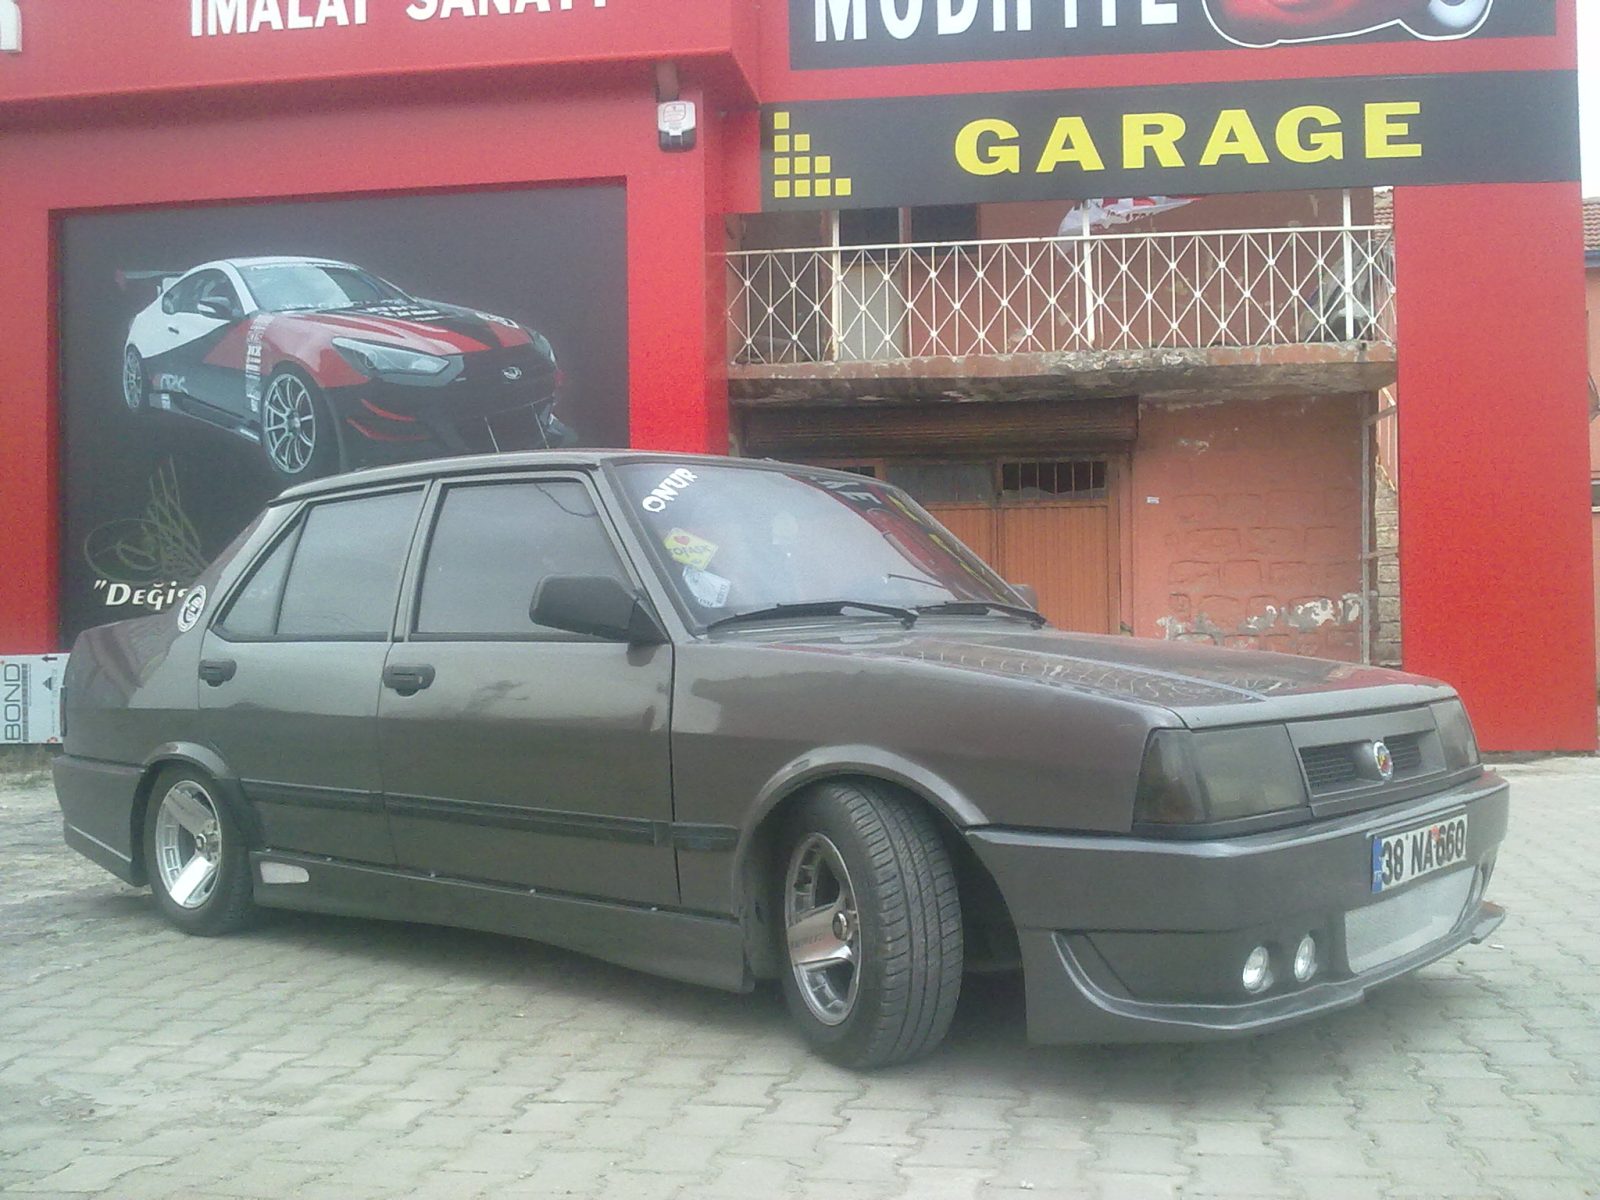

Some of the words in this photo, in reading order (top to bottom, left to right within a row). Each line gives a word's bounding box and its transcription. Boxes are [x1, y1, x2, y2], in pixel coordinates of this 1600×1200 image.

[954, 101, 1423, 176] GARAGE
[642, 467, 698, 513] ONUR
[4, 663, 21, 741] BOND
[1380, 838, 1404, 886] 38
[1411, 829, 1434, 876] NA
